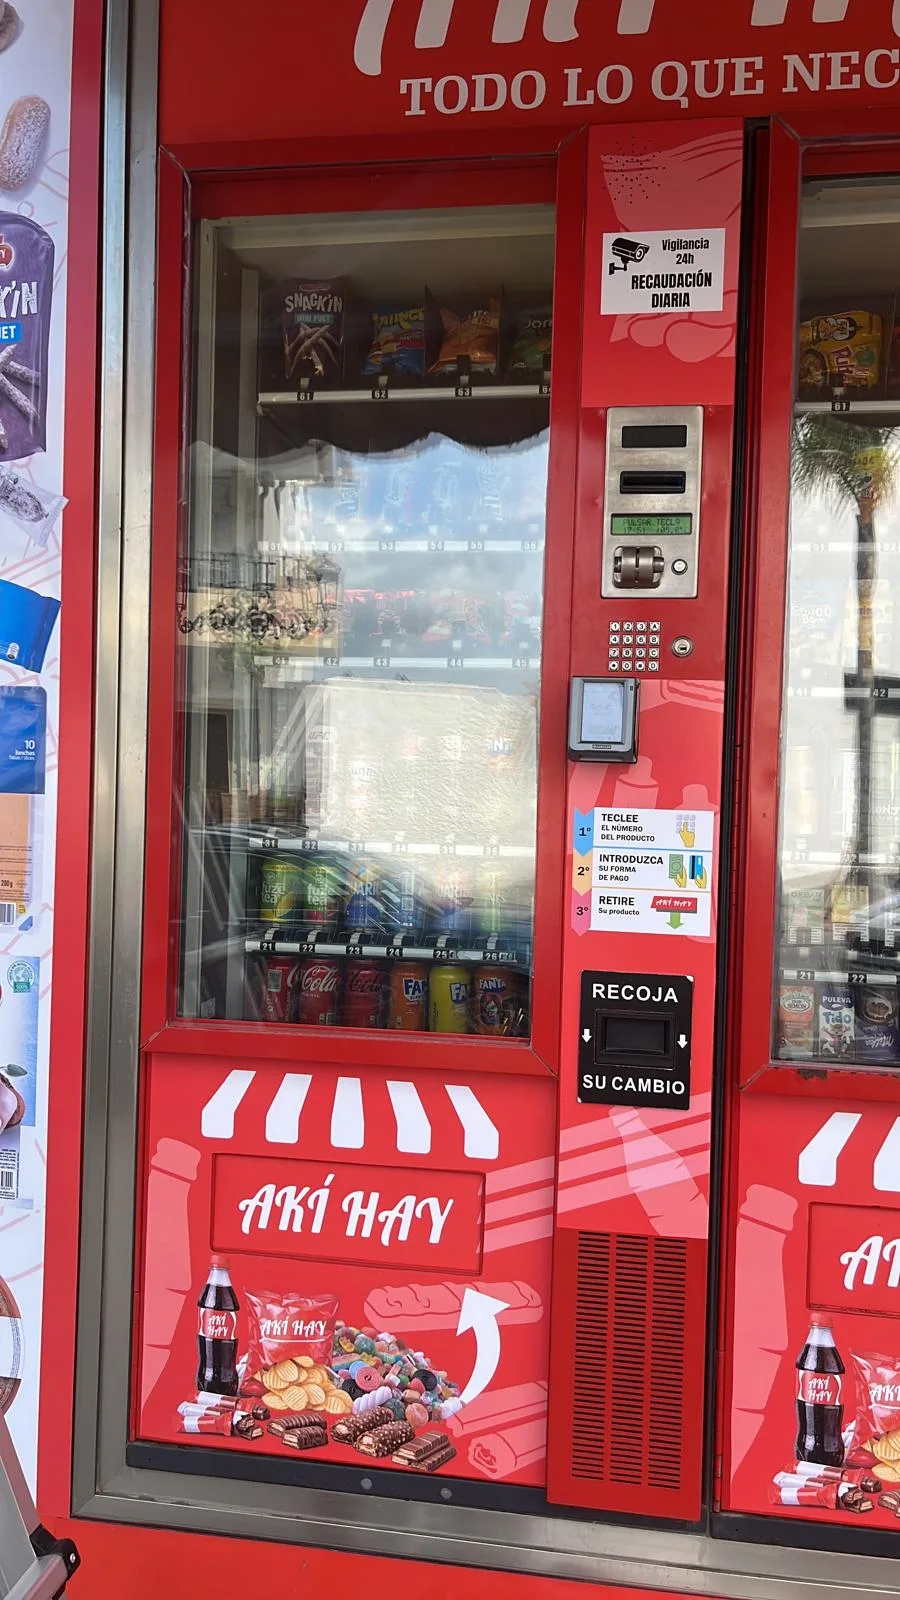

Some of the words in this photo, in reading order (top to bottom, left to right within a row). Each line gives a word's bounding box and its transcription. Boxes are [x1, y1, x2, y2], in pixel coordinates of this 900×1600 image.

[400, 70, 547, 117] TODO
[563, 66, 634, 107] LO
[651, 56, 765, 109] QUE
[662, 238, 710, 252] Vigilancia
[676, 253, 694, 264] 24h
[632, 269, 712, 290] RECAUDACIÓN
[652, 292, 690, 308] DIARIA
[300, 392, 310, 400] 61
[374, 390, 386, 398] 62
[458, 389, 470, 397] 63
[834, 403, 846, 411] 61
[623, 518, 652, 526] PULSAR
[382, 542, 394, 550] 53
[430, 541, 442, 550] 54
[471, 540, 483, 549] 55
[326, 658, 338, 666] 42
[375, 658, 388, 667] 43
[450, 658, 462, 667] 44
[872, 688, 886, 698] 42
[25, 740, 36, 750] 10
[602, 814, 638, 822] TECLEE
[612, 823, 643, 832] NÚMERO
[265, 840, 276, 848] 31
[304, 840, 316, 850] 32
[600, 854, 664, 864] INTRODUZCA
[599, 896, 634, 906] RETIRE
[609, 908, 640, 916] producto
[262, 942, 272, 950] 21
[302, 944, 314, 952] 22
[348, 947, 360, 955] 23
[388, 948, 400, 956] 24
[436, 950, 447, 958] 25
[302, 965, 339, 992] Cola
[800, 972, 811, 980] 21
[852, 974, 864, 983] 22
[592, 983, 678, 1003] RECOJA
[822, 996, 852, 1004] PULEVA
[582, 1074, 606, 1090] SU
[612, 1076, 685, 1095] CAMBIO
[238, 1173, 335, 1234] AKÍ
[342, 1190, 454, 1247] HAY
[208, 1313, 226, 1326] AKÍ
[207, 1326, 228, 1337] HAY
[260, 1316, 289, 1336] AKÍ
[292, 1320, 326, 1338] HAY
[808, 1376, 830, 1390] AKÍ
[808, 1390, 832, 1402] HAY
